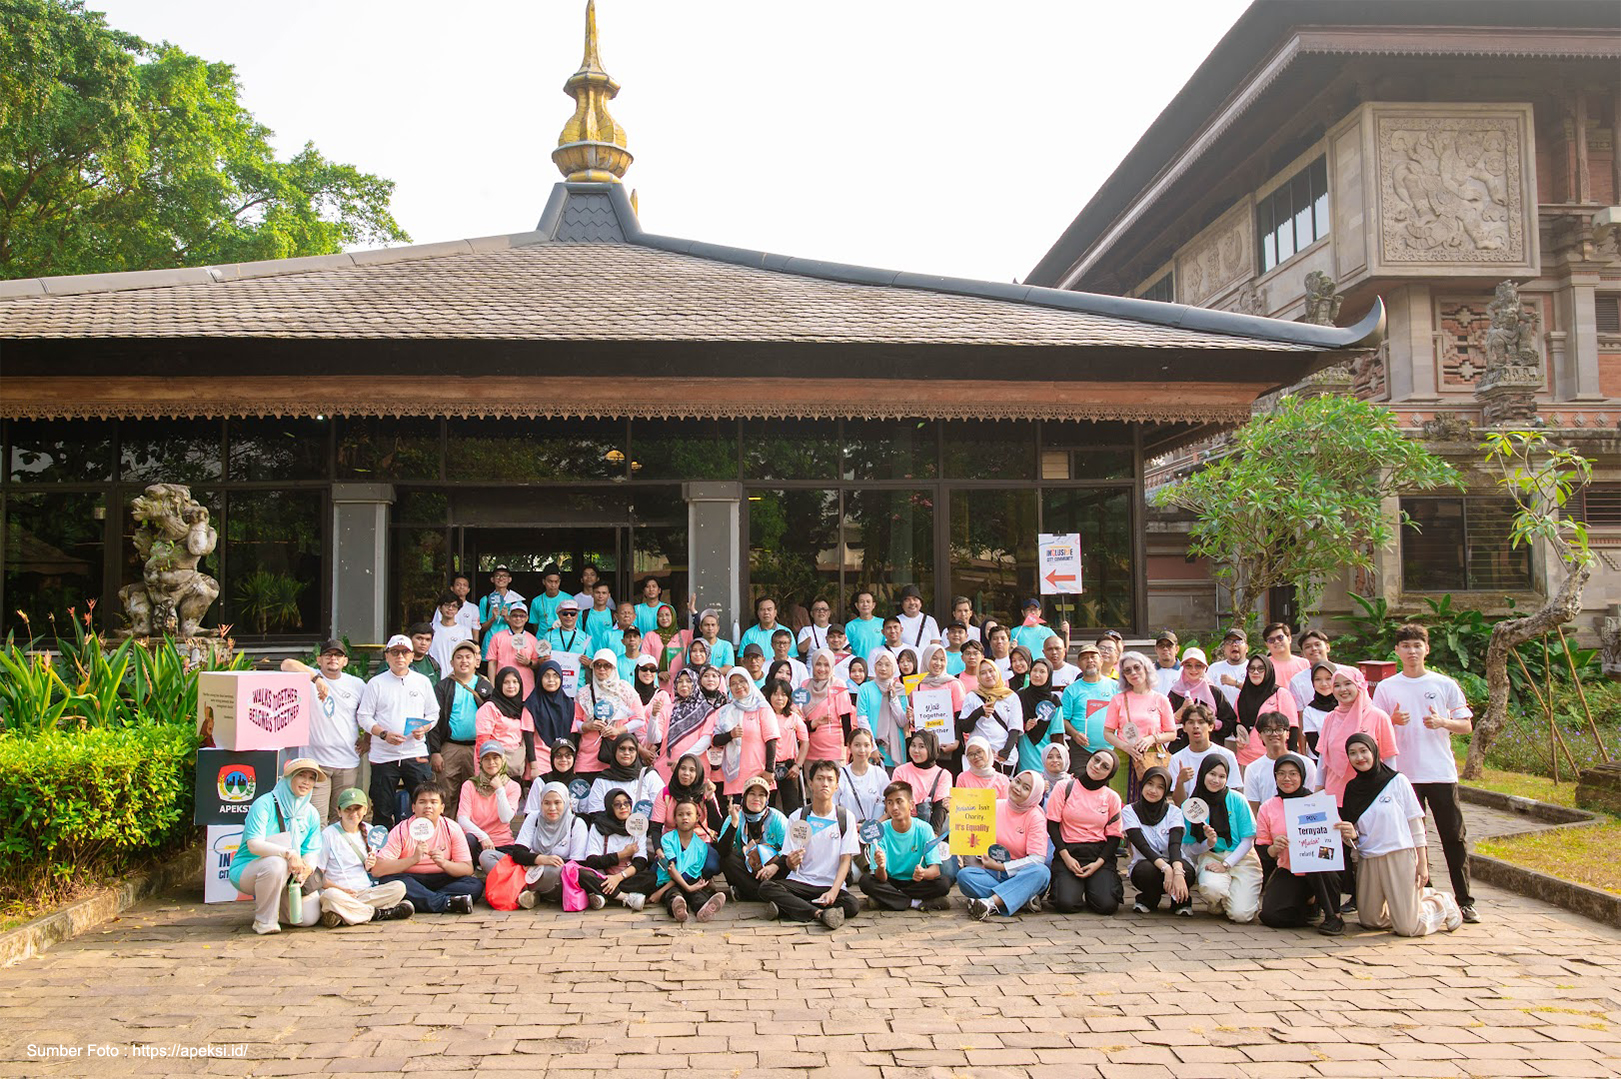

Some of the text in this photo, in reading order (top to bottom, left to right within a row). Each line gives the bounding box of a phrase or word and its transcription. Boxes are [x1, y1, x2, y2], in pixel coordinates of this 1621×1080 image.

[252, 688, 298, 711] WALKS TOGETHER
[248, 704, 300, 733] BELONGS TOGETHER
[966, 824, 990, 832] Equality
[1298, 826, 1328, 835] Ternyata
